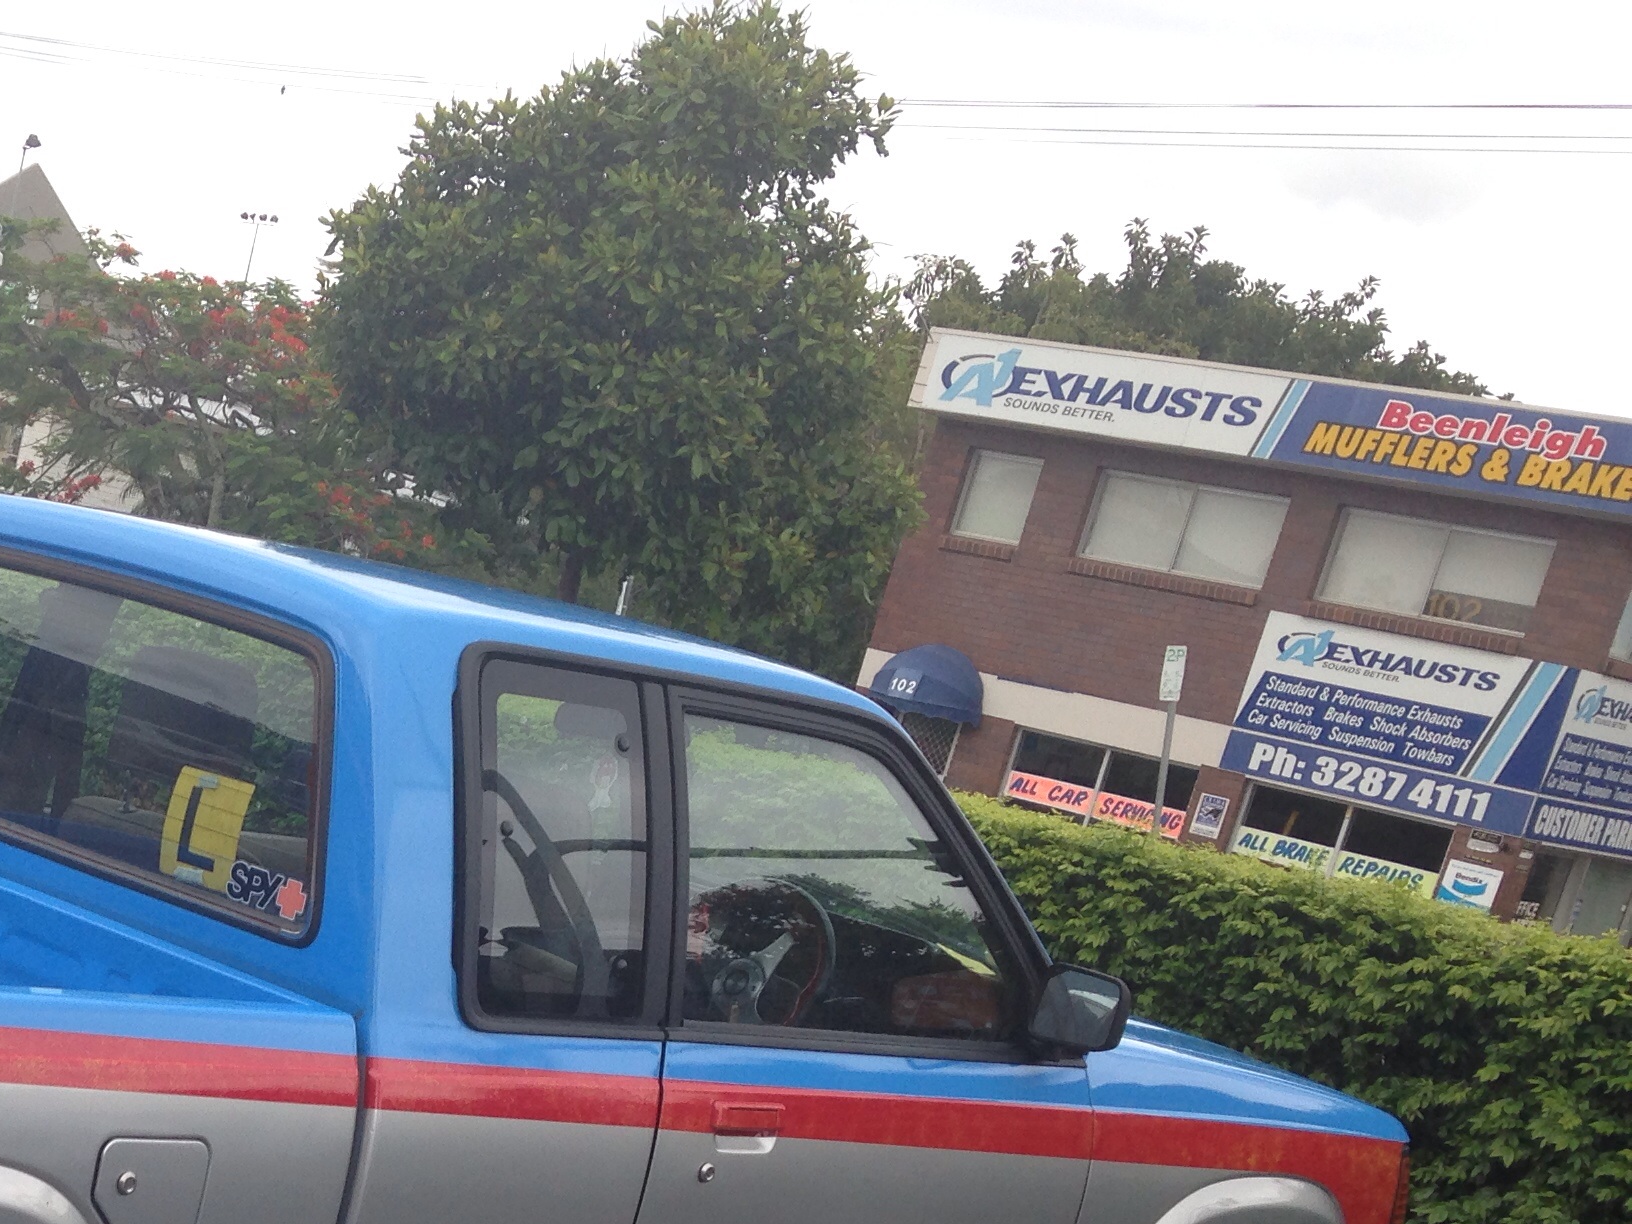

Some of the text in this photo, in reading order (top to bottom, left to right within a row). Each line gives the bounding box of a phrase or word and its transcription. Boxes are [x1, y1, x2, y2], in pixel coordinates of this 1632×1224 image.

[1003, 397, 1116, 423] SOUNDS BETTER.
[1006, 365, 1263, 428] EXHAUSTS
[1303, 421, 1478, 478] MUFFLERS
[1479, 447, 1514, 483] &
[1376, 399, 1608, 462] Beenleigh
[1428, 592, 1482, 621] 102
[1166, 648, 1185, 662] 2P
[1321, 661, 1361, 676] SOUNDS
[1322, 640, 1501, 692] EXHAUSTS
[891, 677, 917, 694] 102
[1266, 675, 1463, 730] Standard & Performance Exhausts
[1247, 708, 1455, 767] Car Servicing Suspension Towbars
[1255, 693, 1473, 751] Extractors Brakes Shock Absorbers
[1009, 777, 1038, 796] ALL
[1048, 785, 1089, 807] CAR
[1248, 742, 1493, 822] Ph: 3287 4111
[177, 785, 216, 872] L
[1534, 804, 1606, 845] CUSTOMER
[1238, 833, 1268, 852] ALL
[1271, 839, 1330, 867] BRAKE
[226, 860, 285, 910] SPY
[1455, 872, 1483, 884] Bendix
